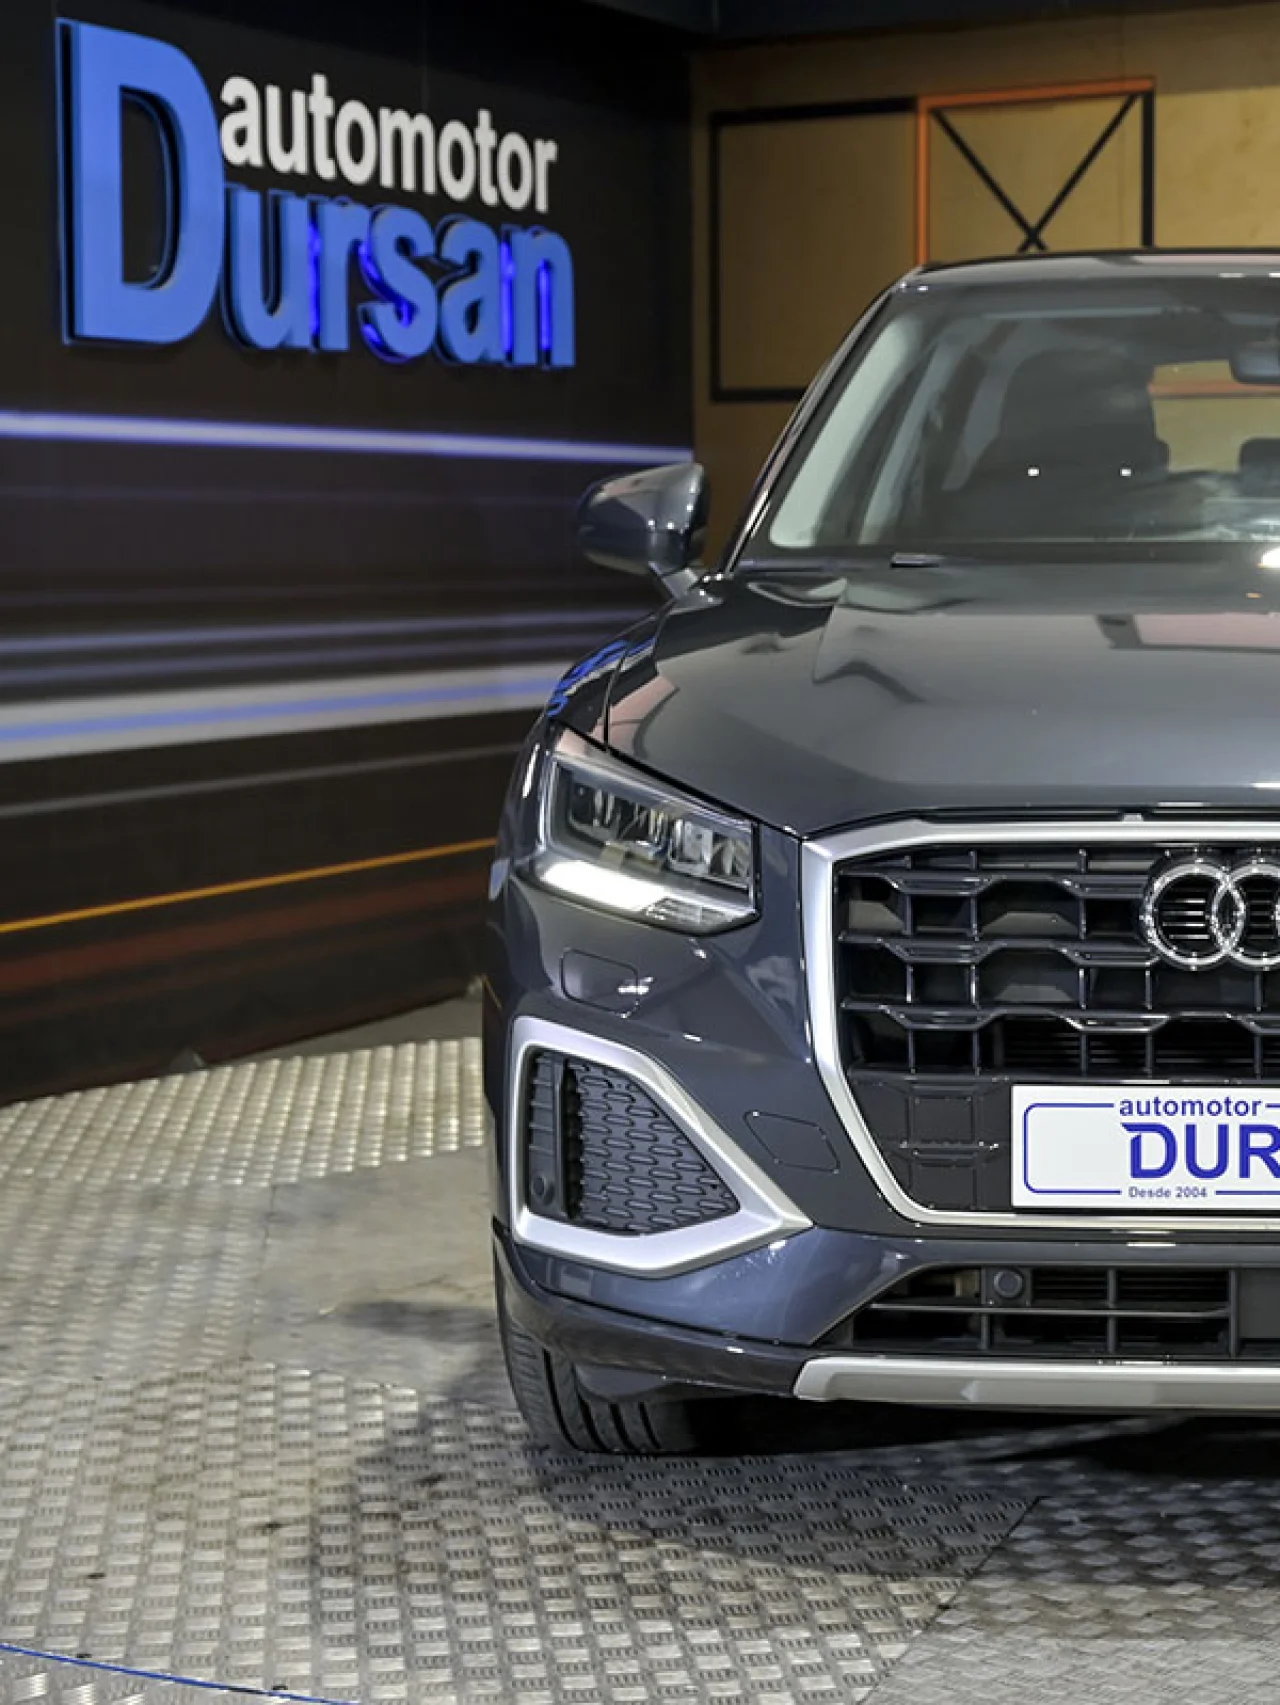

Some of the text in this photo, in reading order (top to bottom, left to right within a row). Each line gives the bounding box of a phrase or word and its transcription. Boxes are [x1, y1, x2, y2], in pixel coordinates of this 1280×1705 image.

[219, 73, 558, 213] automotor
[57, 17, 576, 369] Dursan
[1119, 1096, 1262, 1117] automotor
[1128, 1185, 1208, 1199] Desde 2004
